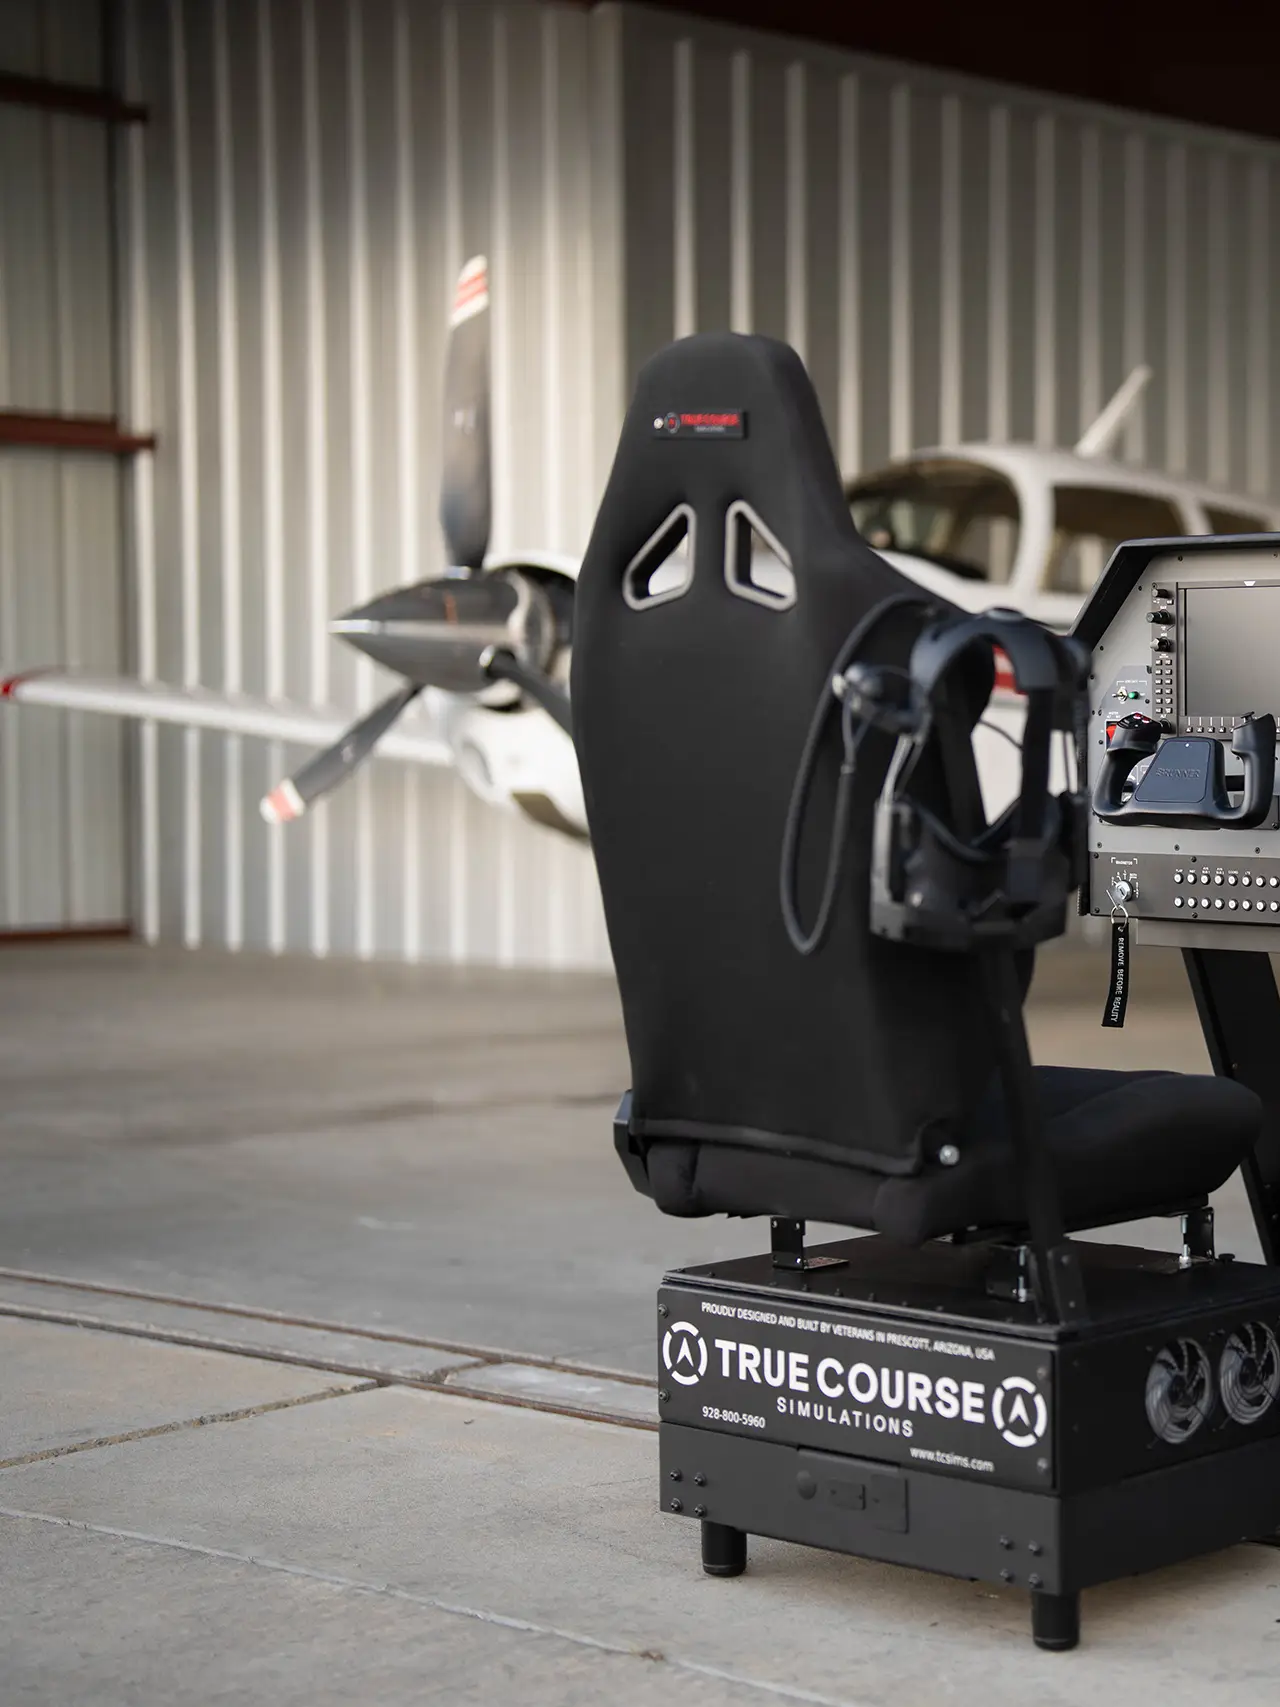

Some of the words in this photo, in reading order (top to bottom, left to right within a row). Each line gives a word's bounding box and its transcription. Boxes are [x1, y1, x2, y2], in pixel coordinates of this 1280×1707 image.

[1117, 937, 1125, 967] REMOVE
[1115, 968, 1124, 995] BEFORE
[1111, 996, 1122, 1022] REALITY
[701, 1302, 737, 1317] PROUDLY
[737, 1308, 777, 1324] DESIGNED
[778, 1315, 796, 1328] AND
[797, 1318, 819, 1332] BUILT
[820, 1321, 832, 1334] BY
[832, 1324, 875, 1341] VETERANS
[875, 1331, 886, 1344] IN
[886, 1332, 932, 1352] PRESCOTT,
[933, 1340, 975, 1359] ARIZONA,
[975, 1347, 996, 1361] USA
[714, 1338, 810, 1393] TRUE
[816, 1357, 986, 1425] COURSE
[702, 1405, 766, 1429] 928-800-5960
[776, 1396, 914, 1438] SIMULATIONS
[909, 1447, 995, 1472] www.tcsims.com
